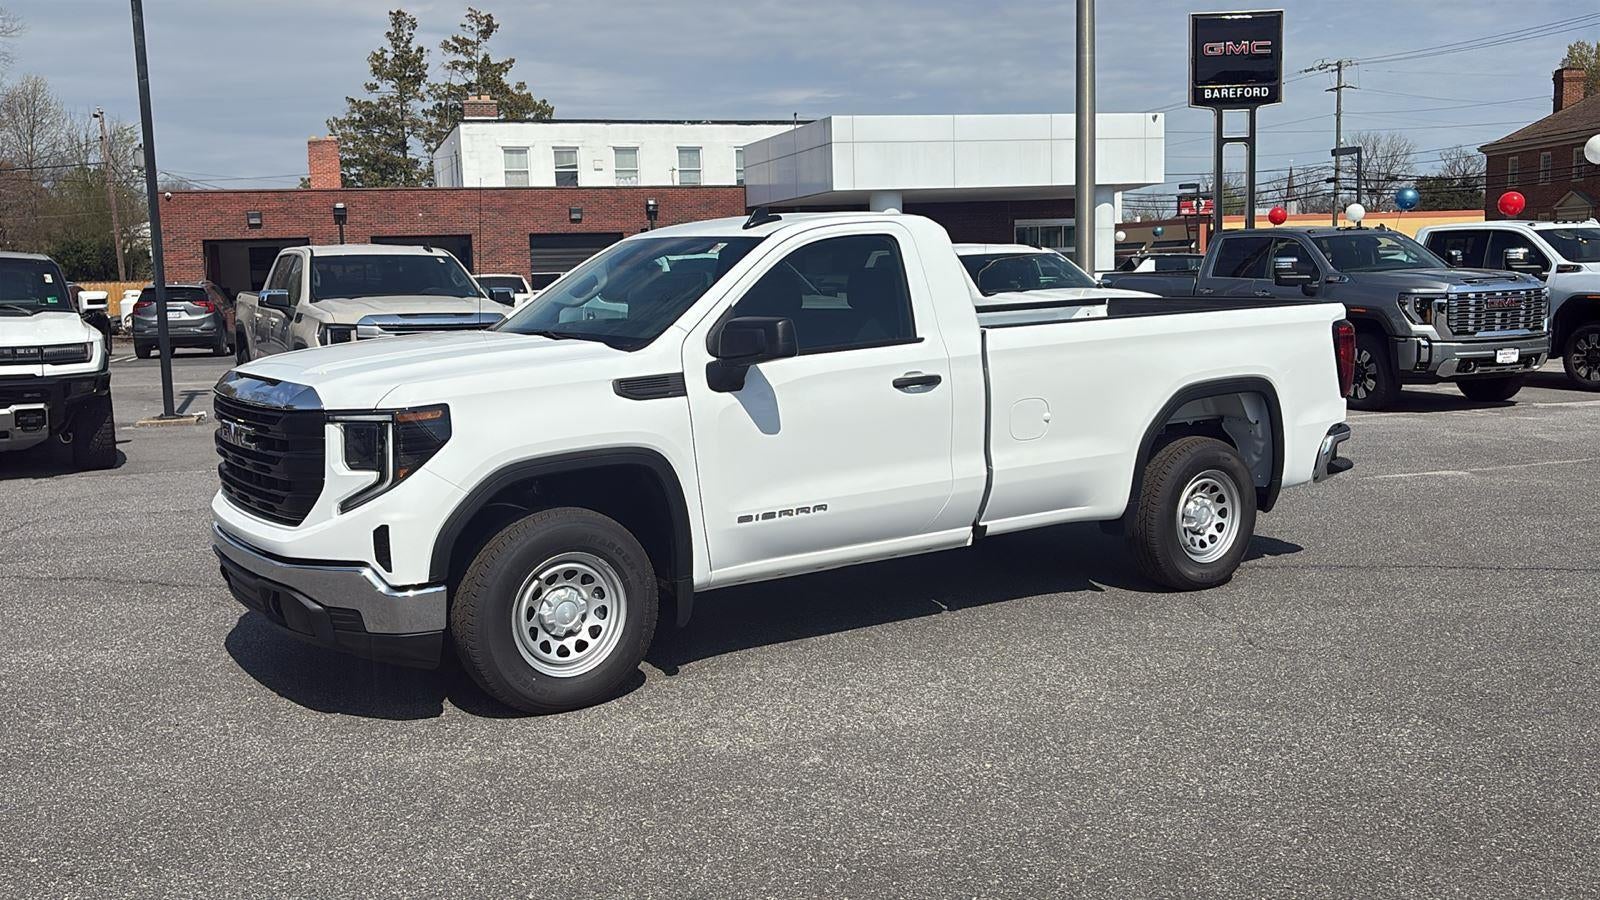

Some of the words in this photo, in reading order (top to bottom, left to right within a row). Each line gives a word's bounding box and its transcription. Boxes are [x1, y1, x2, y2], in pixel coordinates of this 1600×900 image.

[1203, 40, 1272, 56] GMC
[1204, 87, 1269, 99] BAREFORD
[221, 419, 256, 450] GMC
[737, 503, 828, 524] SIERRA
